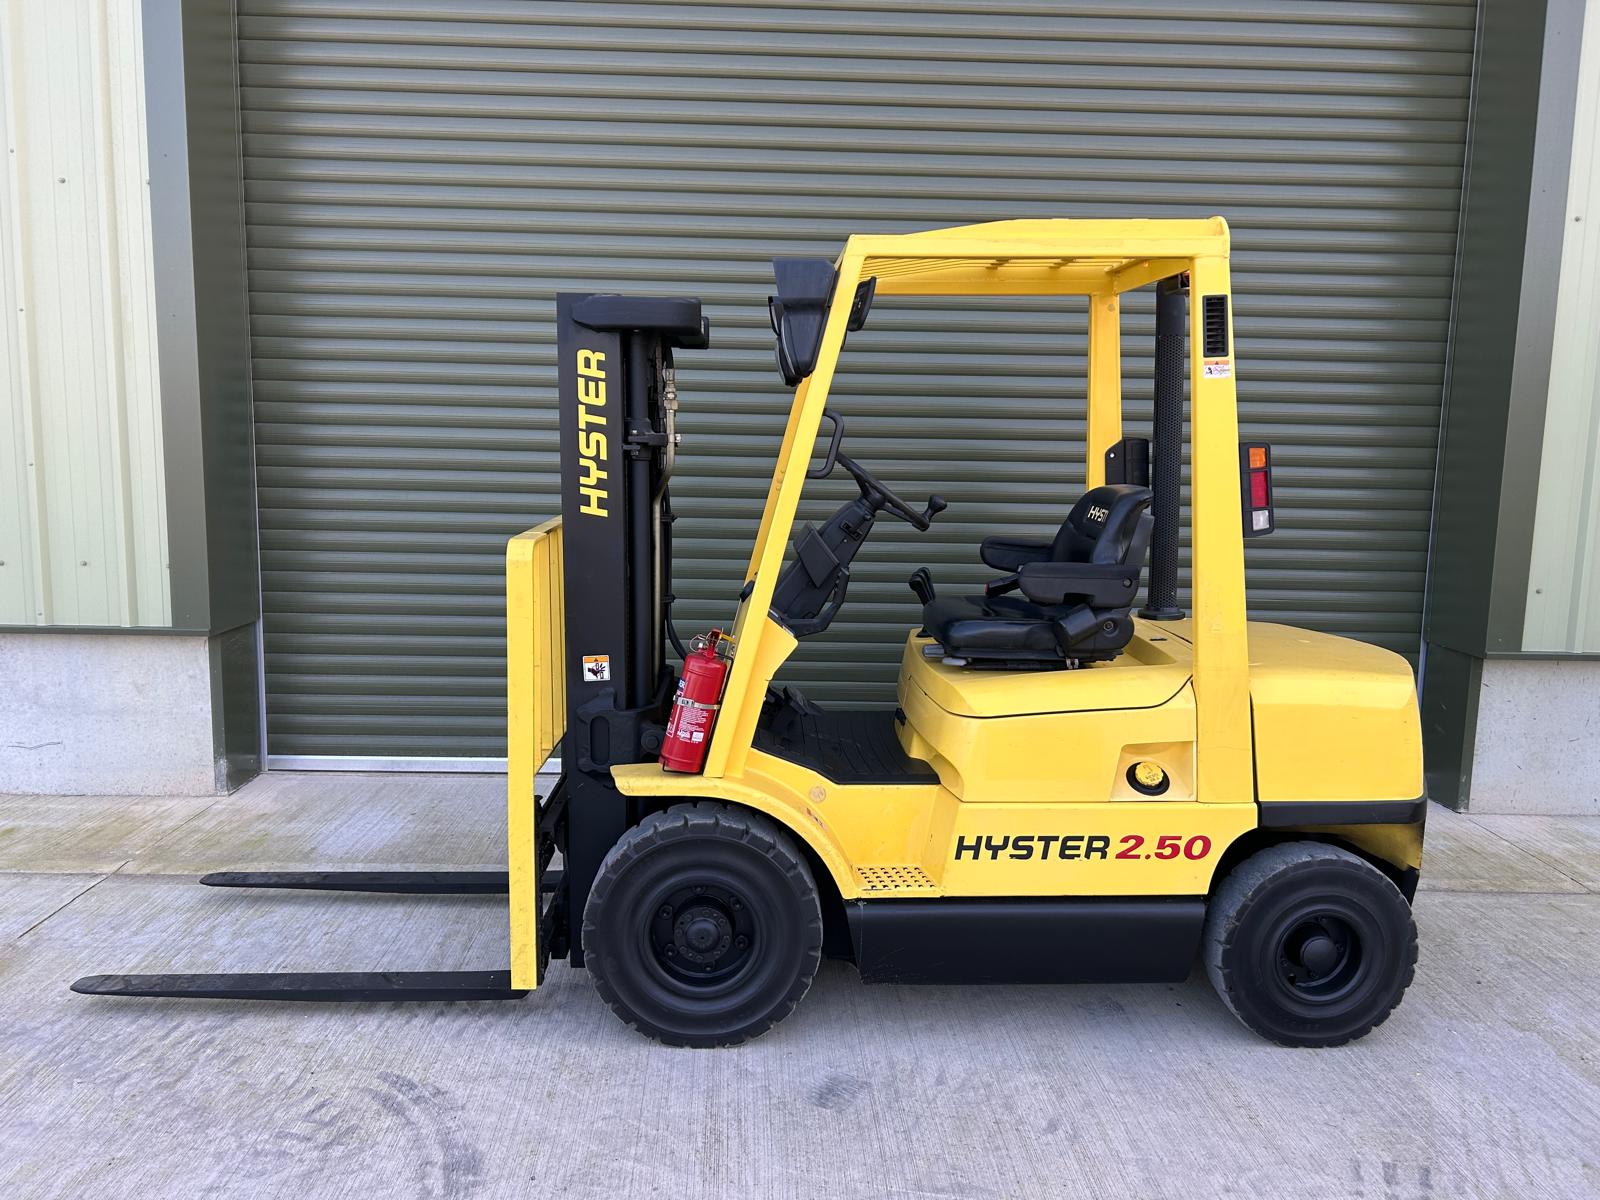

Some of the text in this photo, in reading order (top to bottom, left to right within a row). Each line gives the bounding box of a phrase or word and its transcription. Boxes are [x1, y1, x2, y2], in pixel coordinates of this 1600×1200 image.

[577, 349, 609, 518] HYSTER
[954, 834, 1212, 860] HYSTER 2.50
